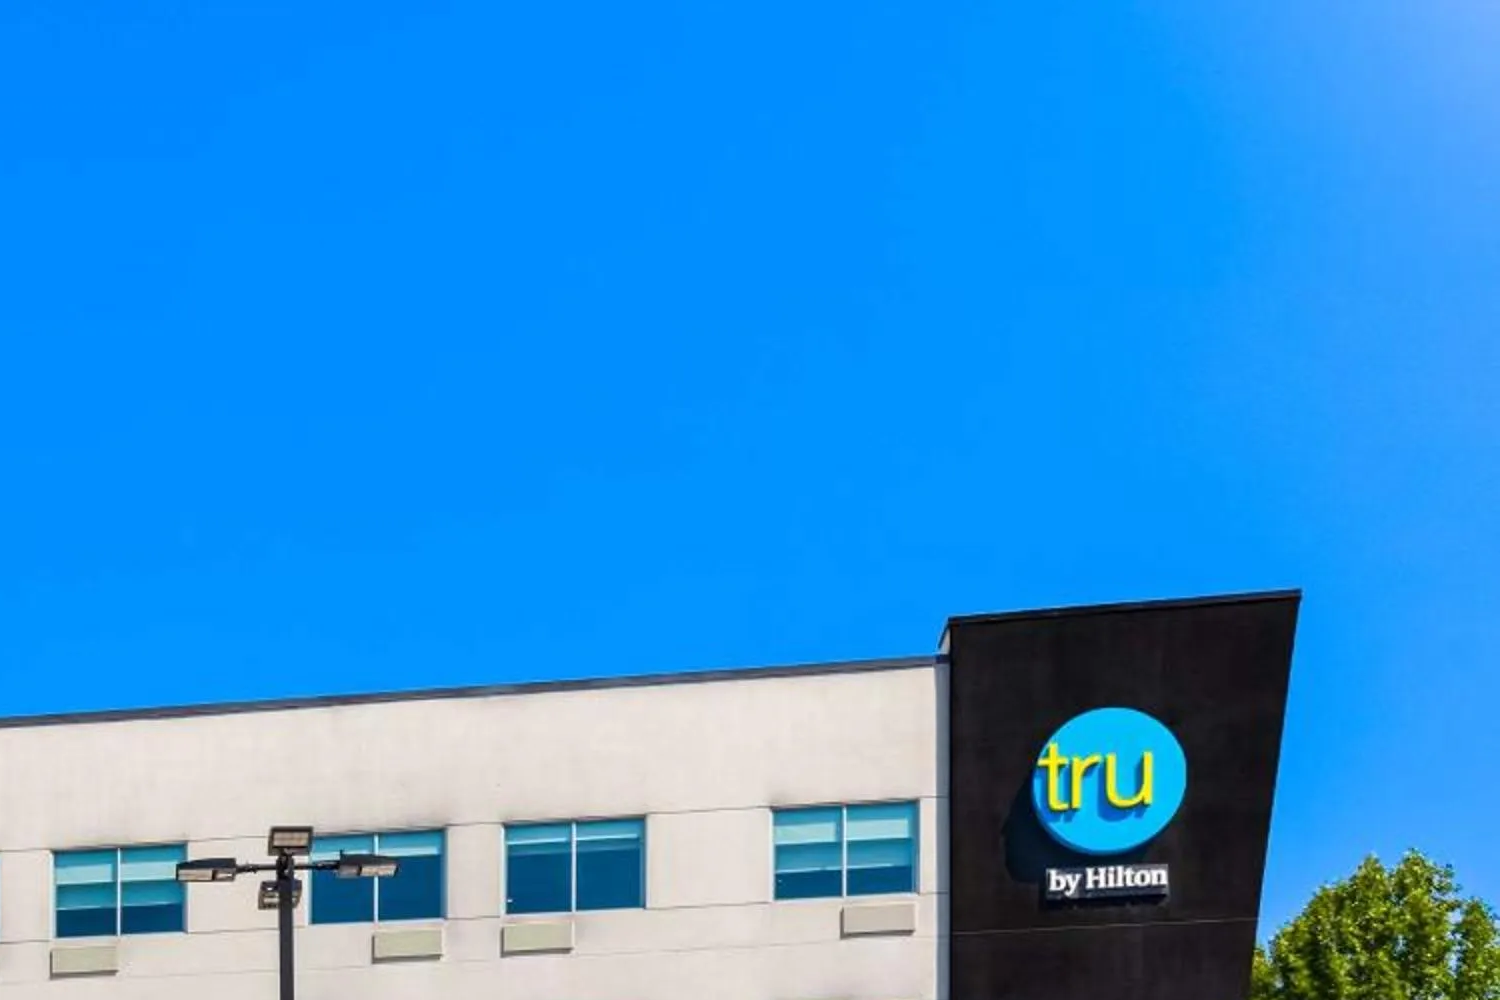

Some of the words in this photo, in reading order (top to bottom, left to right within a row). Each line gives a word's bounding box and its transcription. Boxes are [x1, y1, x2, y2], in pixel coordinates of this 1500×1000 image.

[1037, 742, 1154, 811] tru
[1049, 869, 1081, 896] by
[1085, 865, 1167, 889] Hilton
